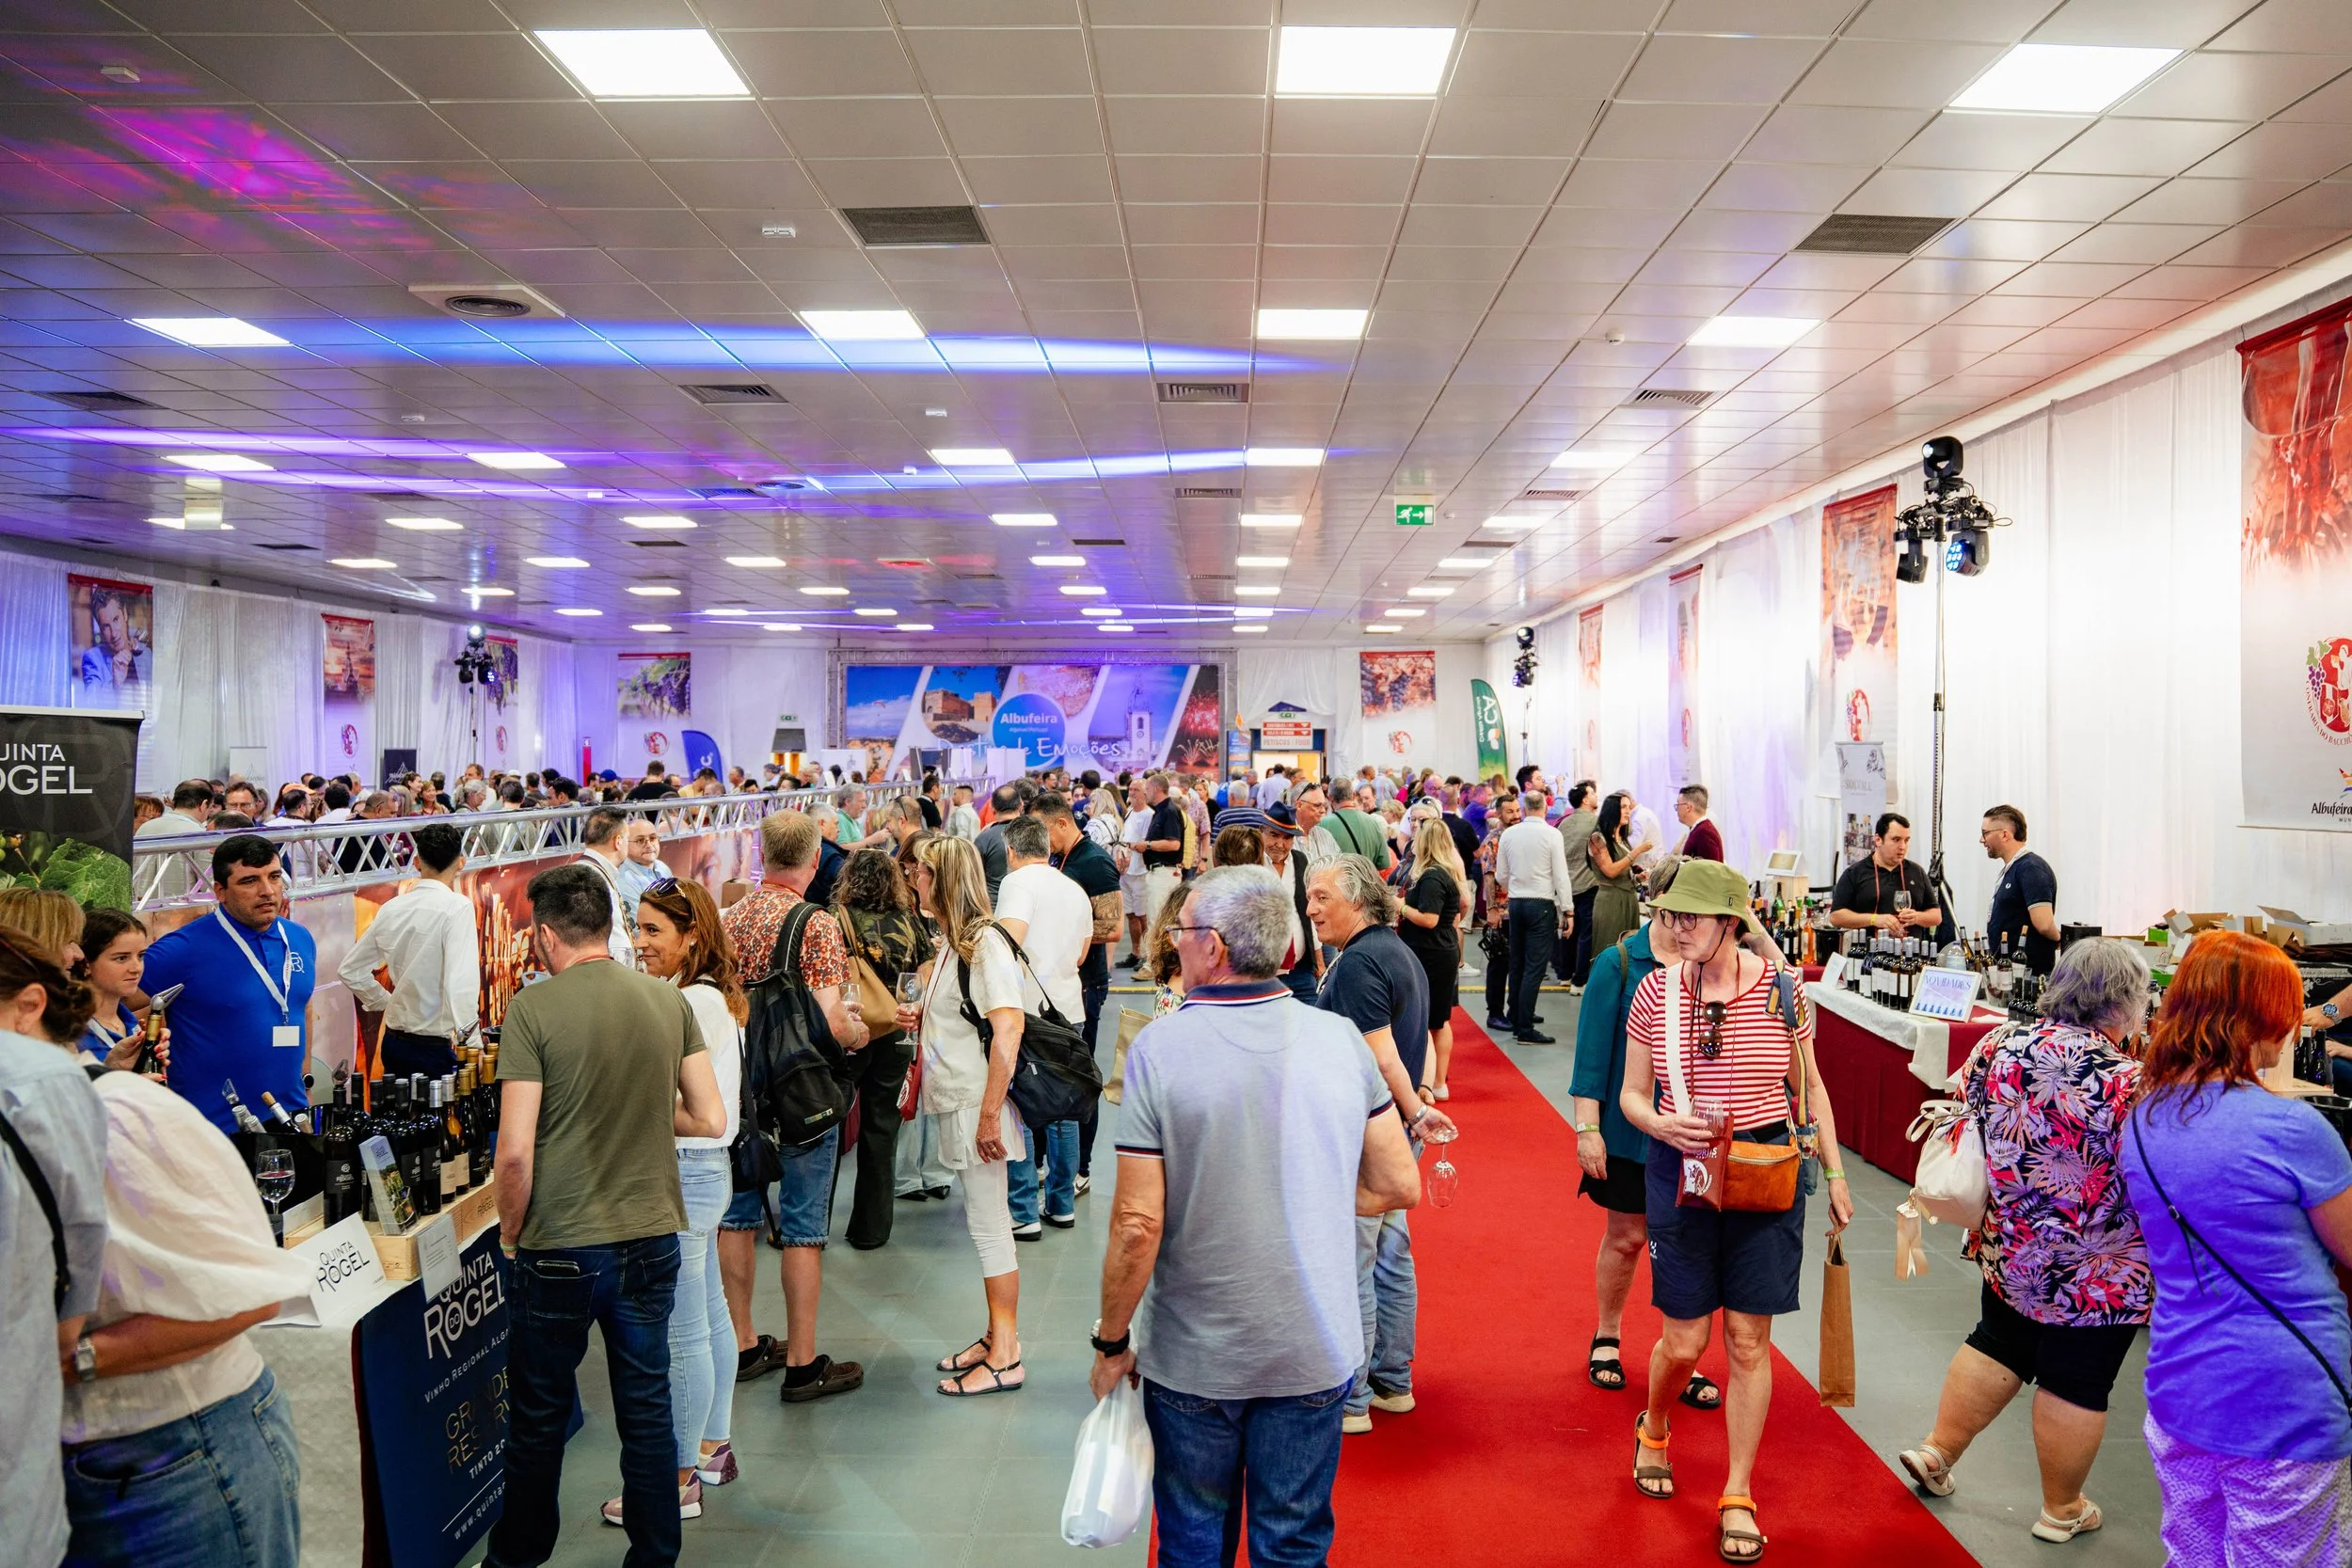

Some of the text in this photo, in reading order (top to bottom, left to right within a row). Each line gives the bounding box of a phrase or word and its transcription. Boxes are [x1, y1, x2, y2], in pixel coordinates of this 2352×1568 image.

[1000, 712, 1057, 724] Albufeira
[0, 764, 93, 796] GEL
[1925, 975, 1971, 990] NOVIDADES
[320, 1241, 354, 1266] QUINTA
[316, 1250, 371, 1292] ROGEL
[423, 1271, 505, 1360] ROGEL
[449, 1313, 460, 1329] DO
[424, 1377, 451, 1403] VINHO
[452, 1345, 490, 1381] REGIONAL
[469, 1450, 494, 1480] TINTO
